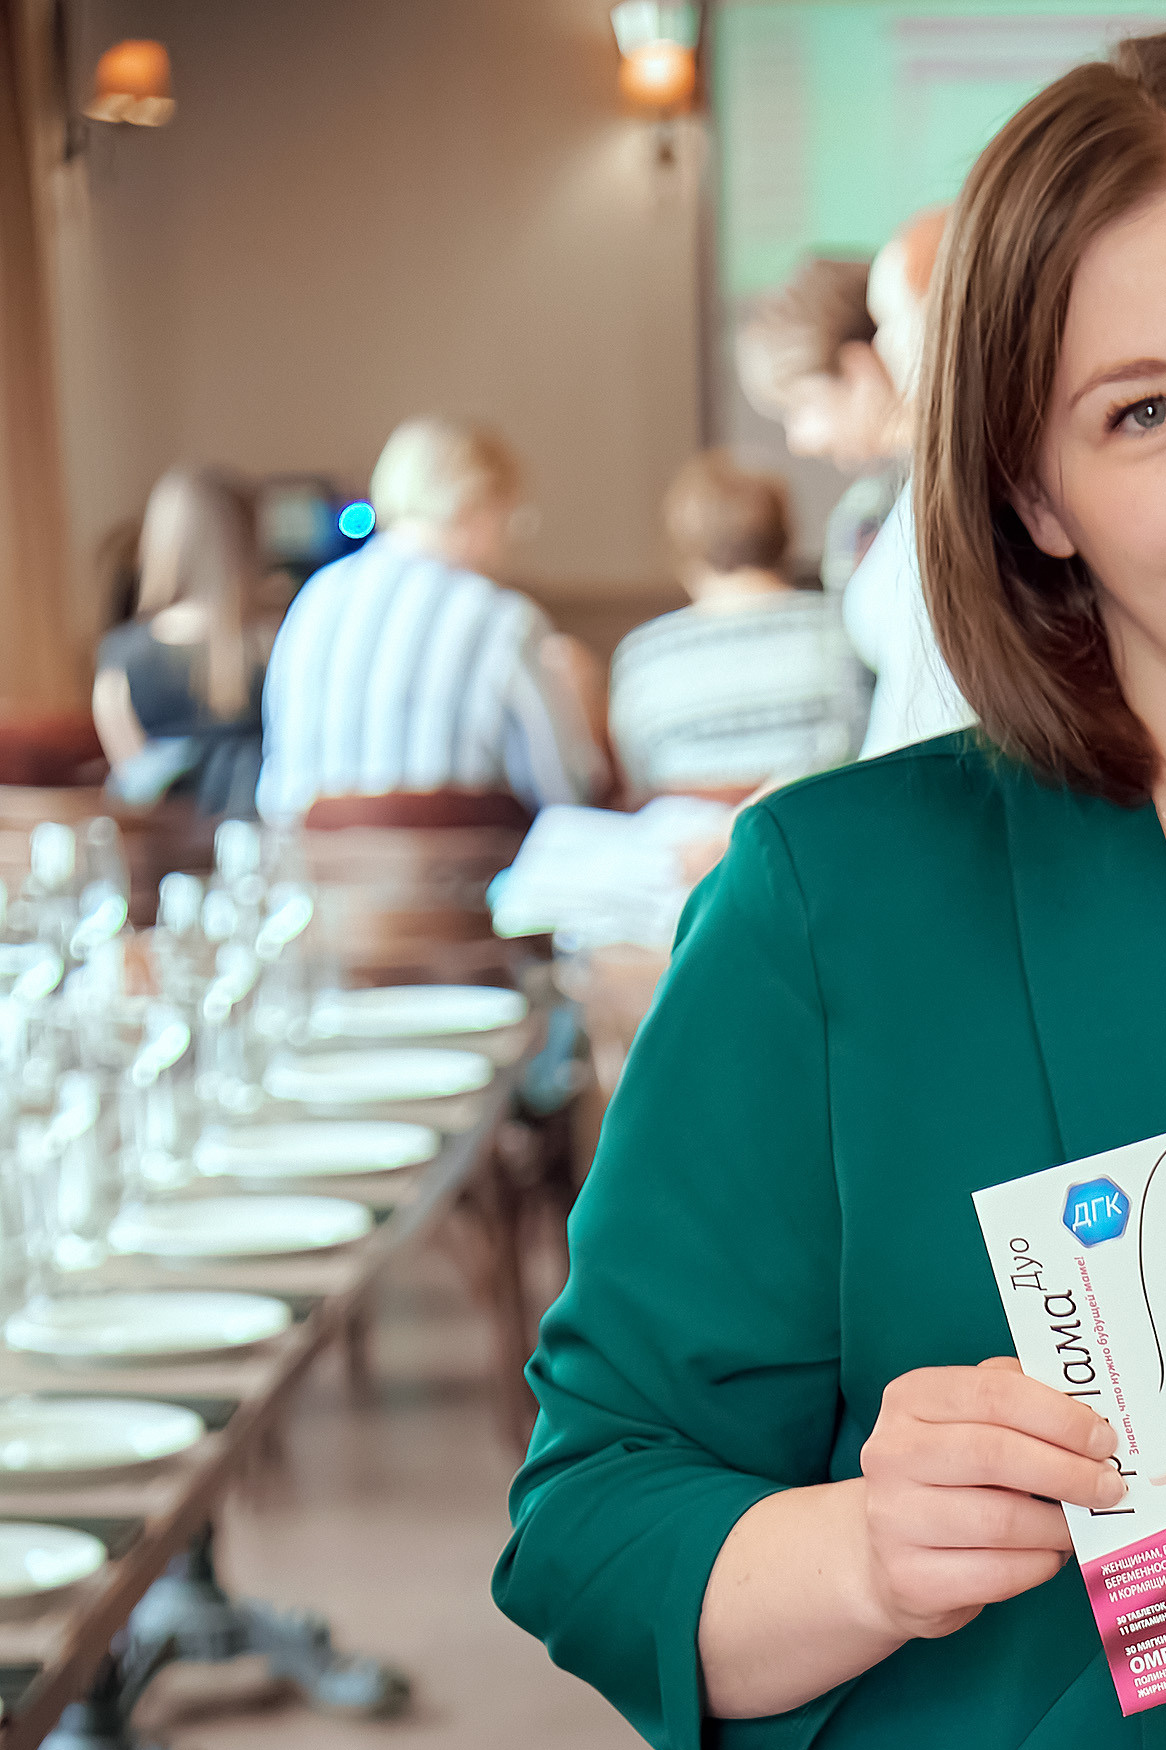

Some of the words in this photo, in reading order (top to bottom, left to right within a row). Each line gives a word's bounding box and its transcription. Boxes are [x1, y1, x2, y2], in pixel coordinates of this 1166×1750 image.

[1072, 1192, 1122, 1232] ДГК
[1009, 1237, 1048, 1291] Дуо
[1074, 1255, 1094, 1293] маме!
[1084, 1294, 1110, 1346] будущей
[1103, 1347, 1122, 1386] нужно
[1113, 1388, 1127, 1412] что
[1122, 1413, 1140, 1456] Знает,
[1101, 1548, 1164, 1576] ЖЕНЩИНАМ,
[1109, 1592, 1119, 1604] И
[1116, 1615, 1126, 1626] 30
[1119, 1625, 1130, 1636] 11
[1125, 1645, 1136, 1656] 30
